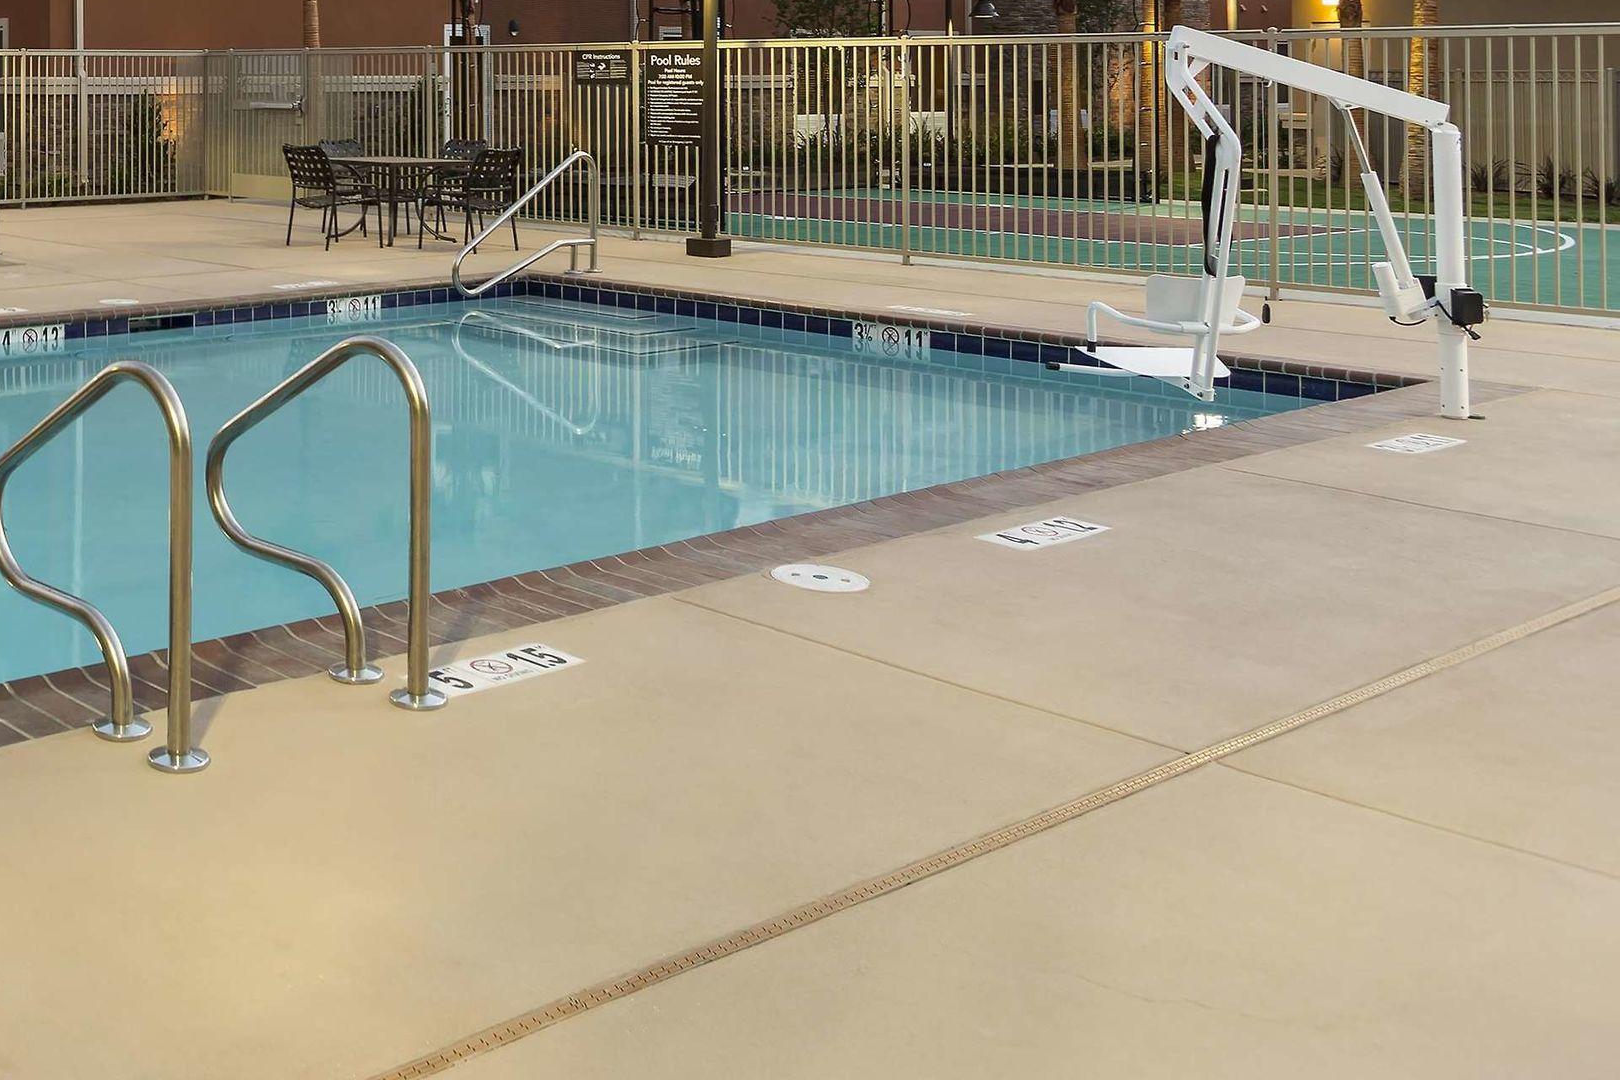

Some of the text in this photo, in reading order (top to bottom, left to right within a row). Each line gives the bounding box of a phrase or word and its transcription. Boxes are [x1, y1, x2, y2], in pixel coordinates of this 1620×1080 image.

[650, 54, 701, 65] Pool Rules
[428, 670, 474, 689] 5
